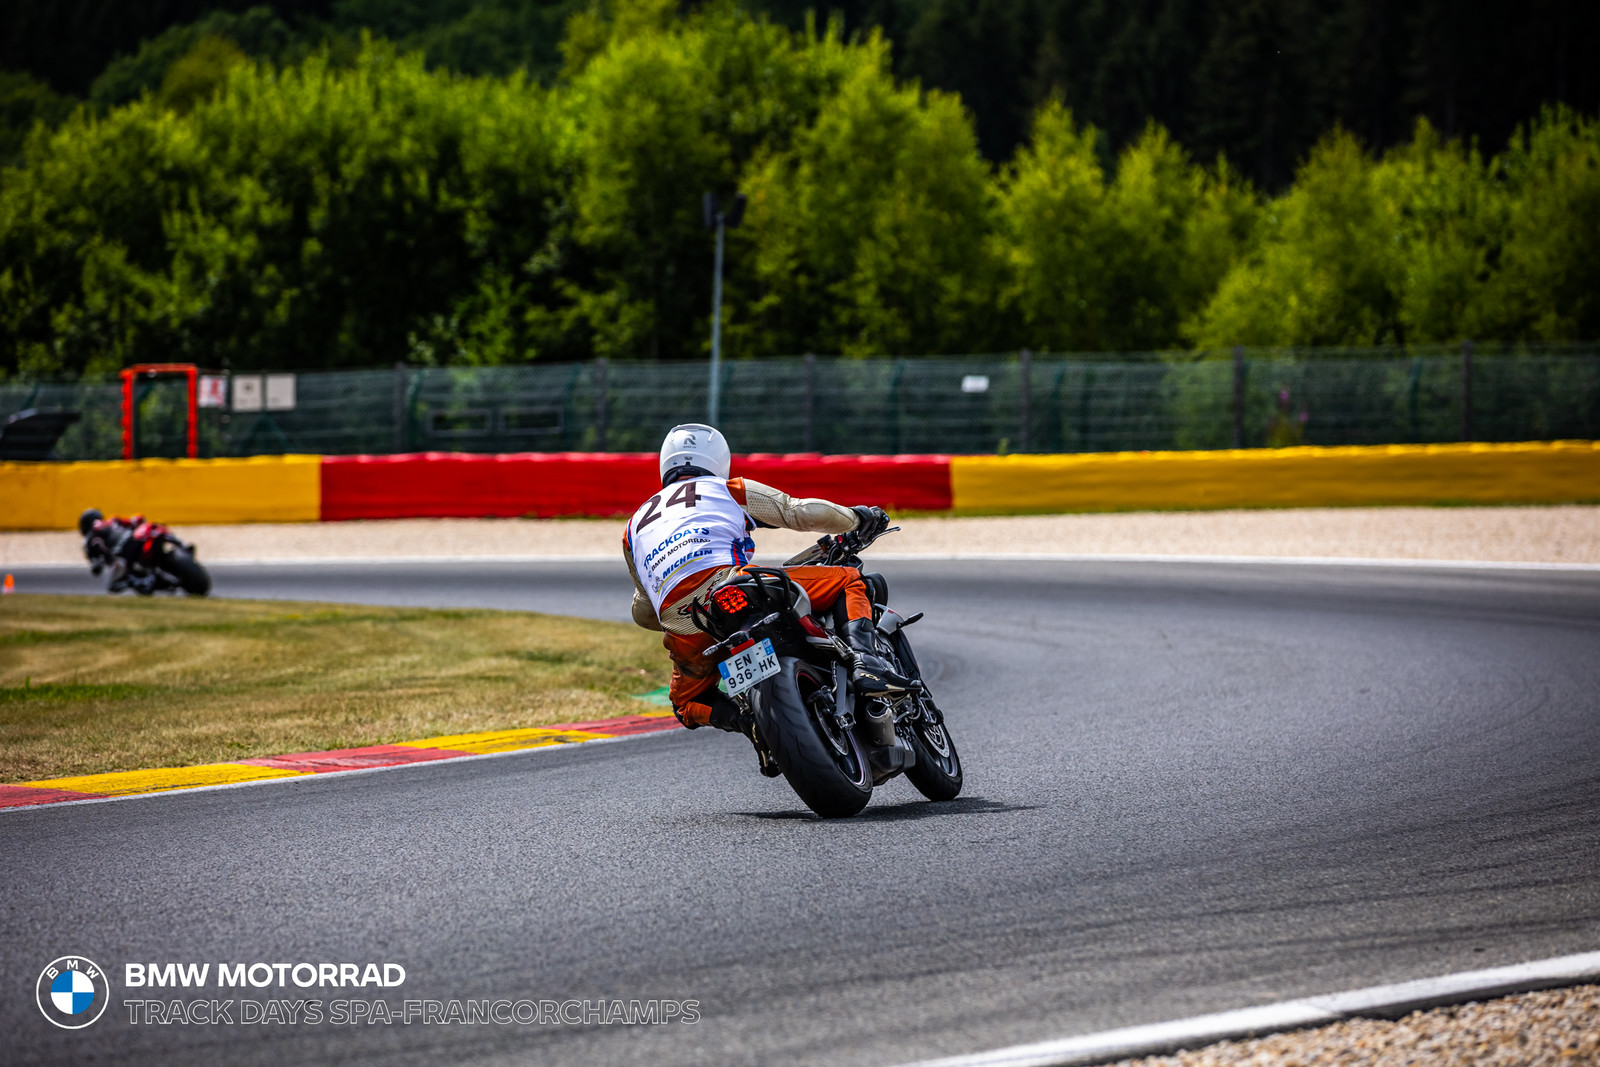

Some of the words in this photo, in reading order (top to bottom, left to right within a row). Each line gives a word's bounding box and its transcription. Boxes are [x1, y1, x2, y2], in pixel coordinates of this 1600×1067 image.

[636, 481, 701, 534] 24
[644, 527, 710, 570] TRACKDAYS
[651, 554, 667, 571] BMW
[667, 537, 711, 557] MOTORRAD
[662, 549, 713, 579] MICHELIN
[734, 653, 752, 671] EN
